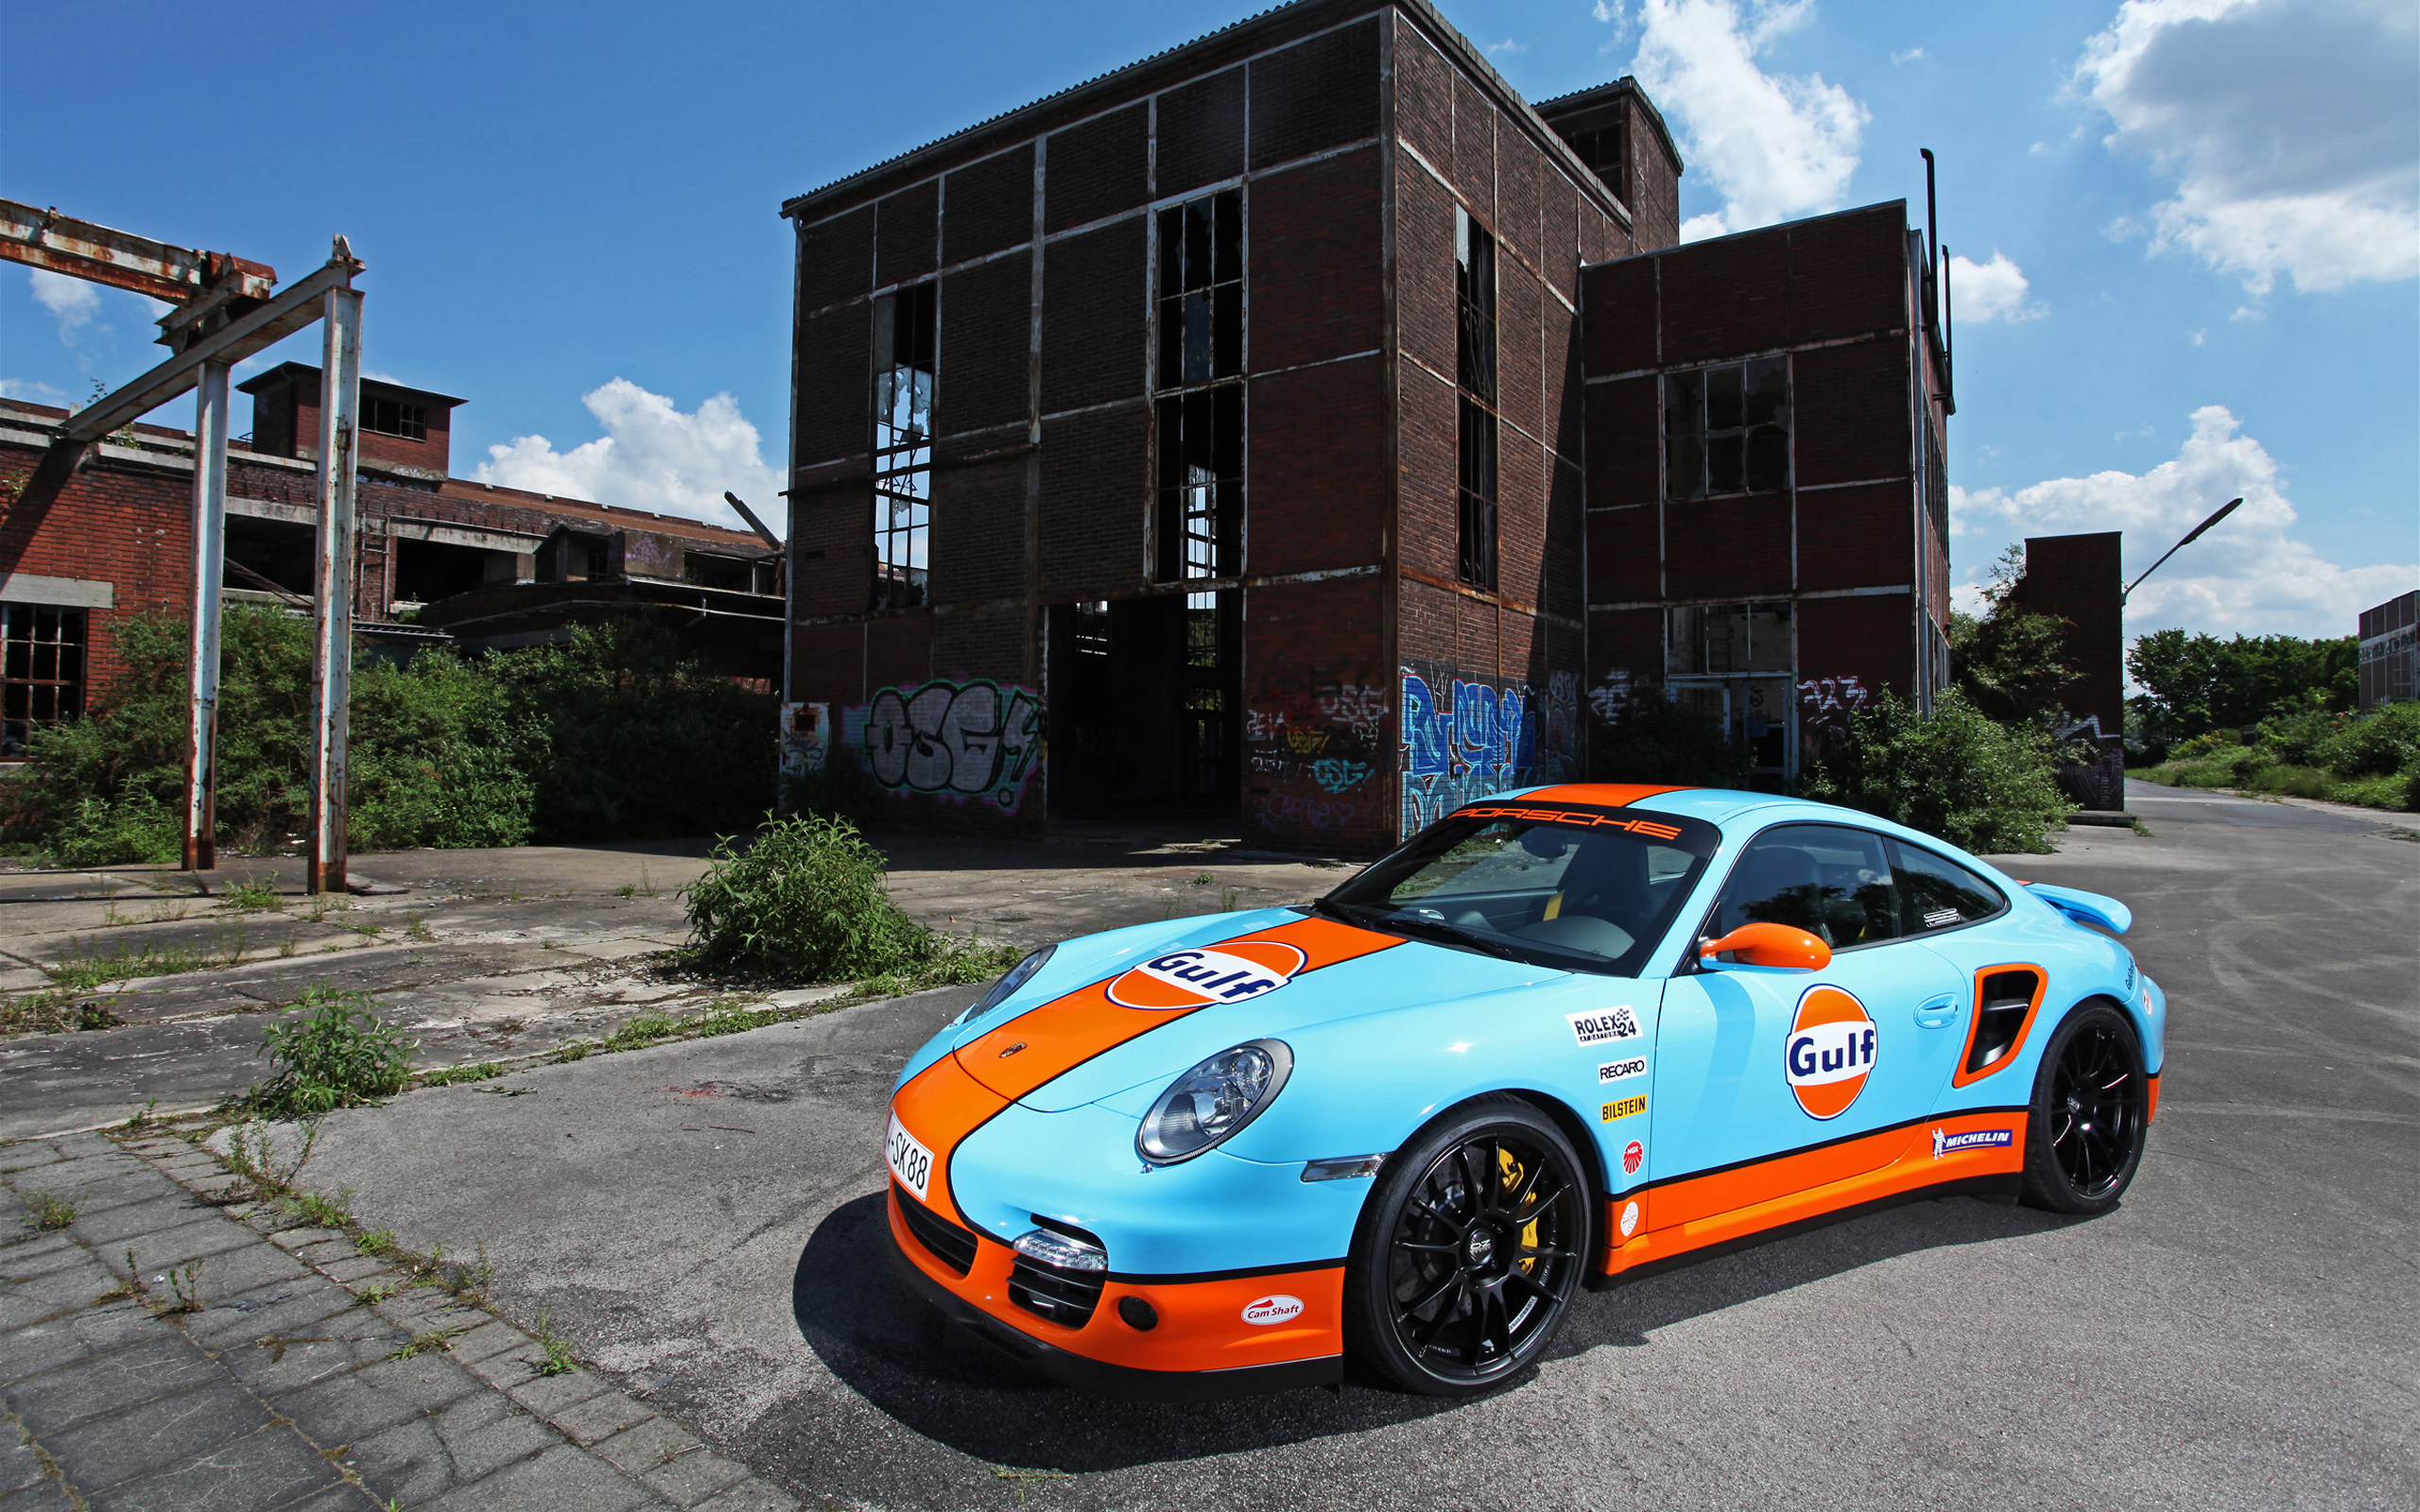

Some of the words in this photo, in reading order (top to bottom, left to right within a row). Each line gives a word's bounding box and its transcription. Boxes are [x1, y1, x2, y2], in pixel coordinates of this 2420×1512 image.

[1447, 807, 1683, 841] PORSCHE
[1147, 952, 1276, 999] Gulf
[1574, 1014, 1619, 1036] ROLEX
[1617, 1020, 1637, 1038] 24
[1789, 1028, 1875, 1077] Gulf
[1599, 1059, 1645, 1080] RECARO
[1601, 1096, 1646, 1121] BILSTEIN
[1945, 1132, 2010, 1148] MICHELIN
[1247, 1310, 1270, 1319] Cam
[1270, 1304, 1300, 1316] Shaft
